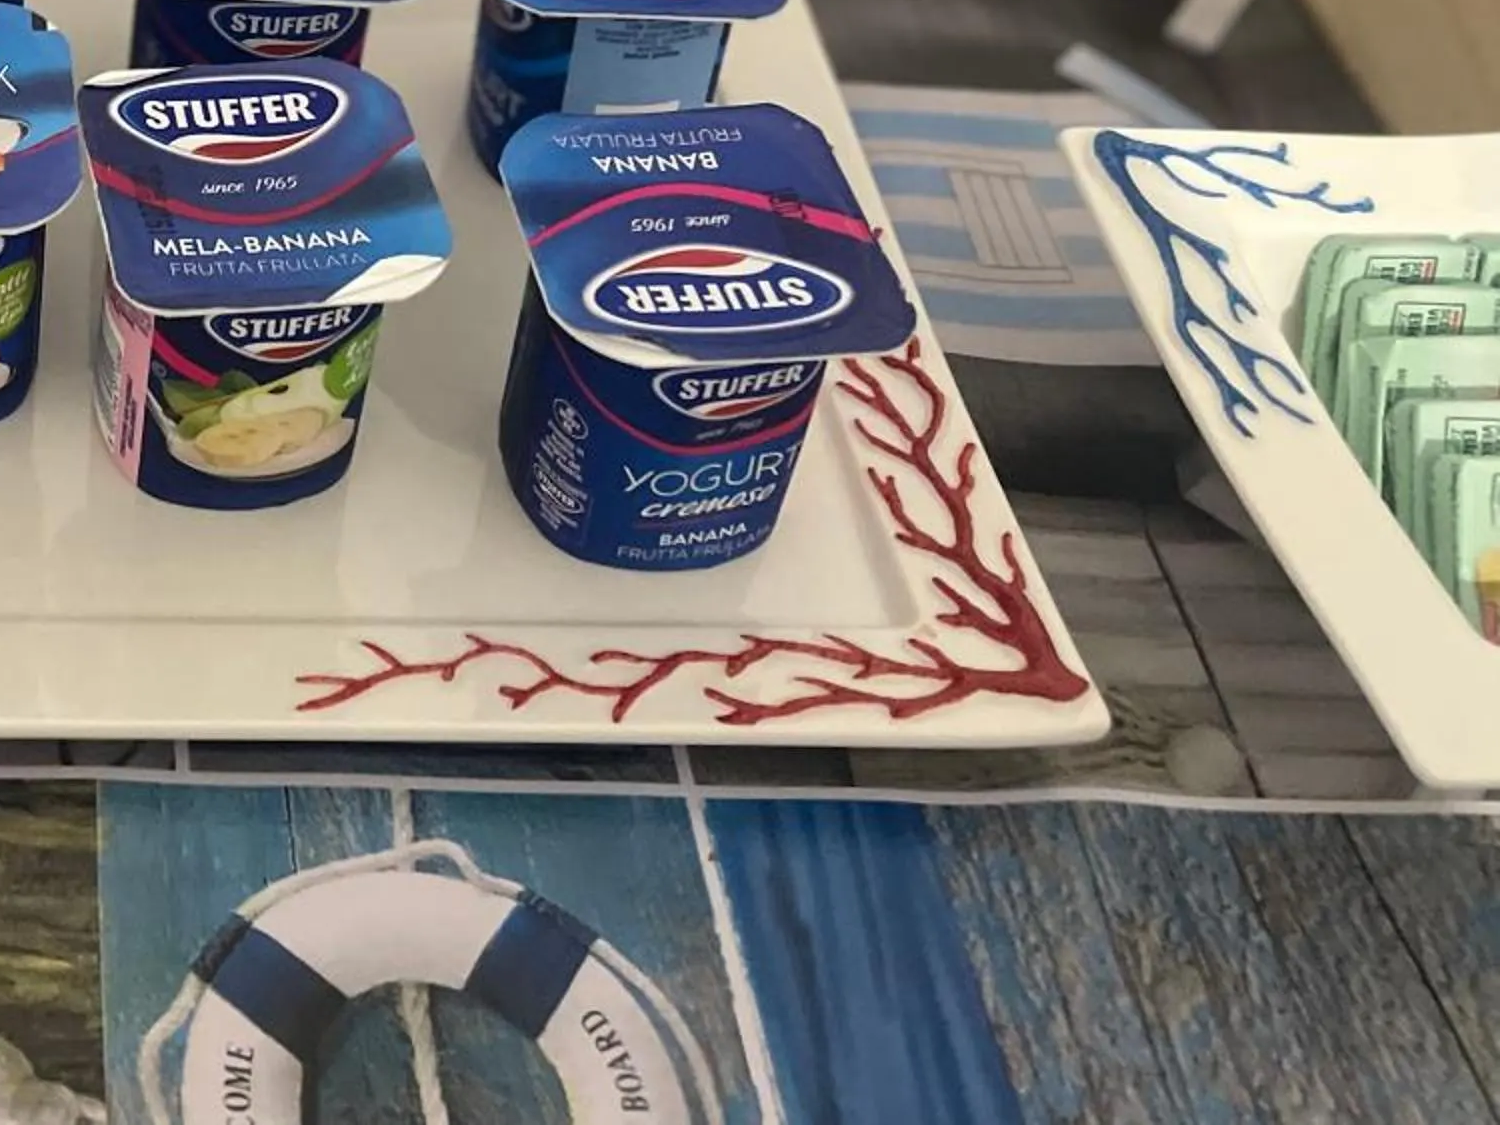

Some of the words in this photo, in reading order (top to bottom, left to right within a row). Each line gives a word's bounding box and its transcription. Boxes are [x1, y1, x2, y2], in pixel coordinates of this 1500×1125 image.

[231, 12, 340, 35] STUFFER
[145, 91, 315, 131] STUFFER
[553, 133, 659, 148] FRULLATA
[663, 128, 741, 144] FRUTTA
[592, 151, 718, 174] BANANA
[201, 179, 244, 194] since
[254, 175, 298, 192] 1965
[631, 218, 674, 233] 1965
[685, 214, 730, 227] since
[153, 227, 371, 256] MELA-BANANA
[169, 260, 252, 277] FRUTTA
[257, 252, 368, 275] FRULLATA
[618, 275, 813, 315] STUFFER
[229, 307, 352, 339] STUFFER
[679, 364, 804, 400] STUFFER
[623, 442, 802, 497] YOGURT
[640, 483, 776, 518] cremoso
[660, 522, 747, 546] BANANA
[617, 546, 688, 562] FRUTTA
[581, 1010, 649, 1111] BOARD
